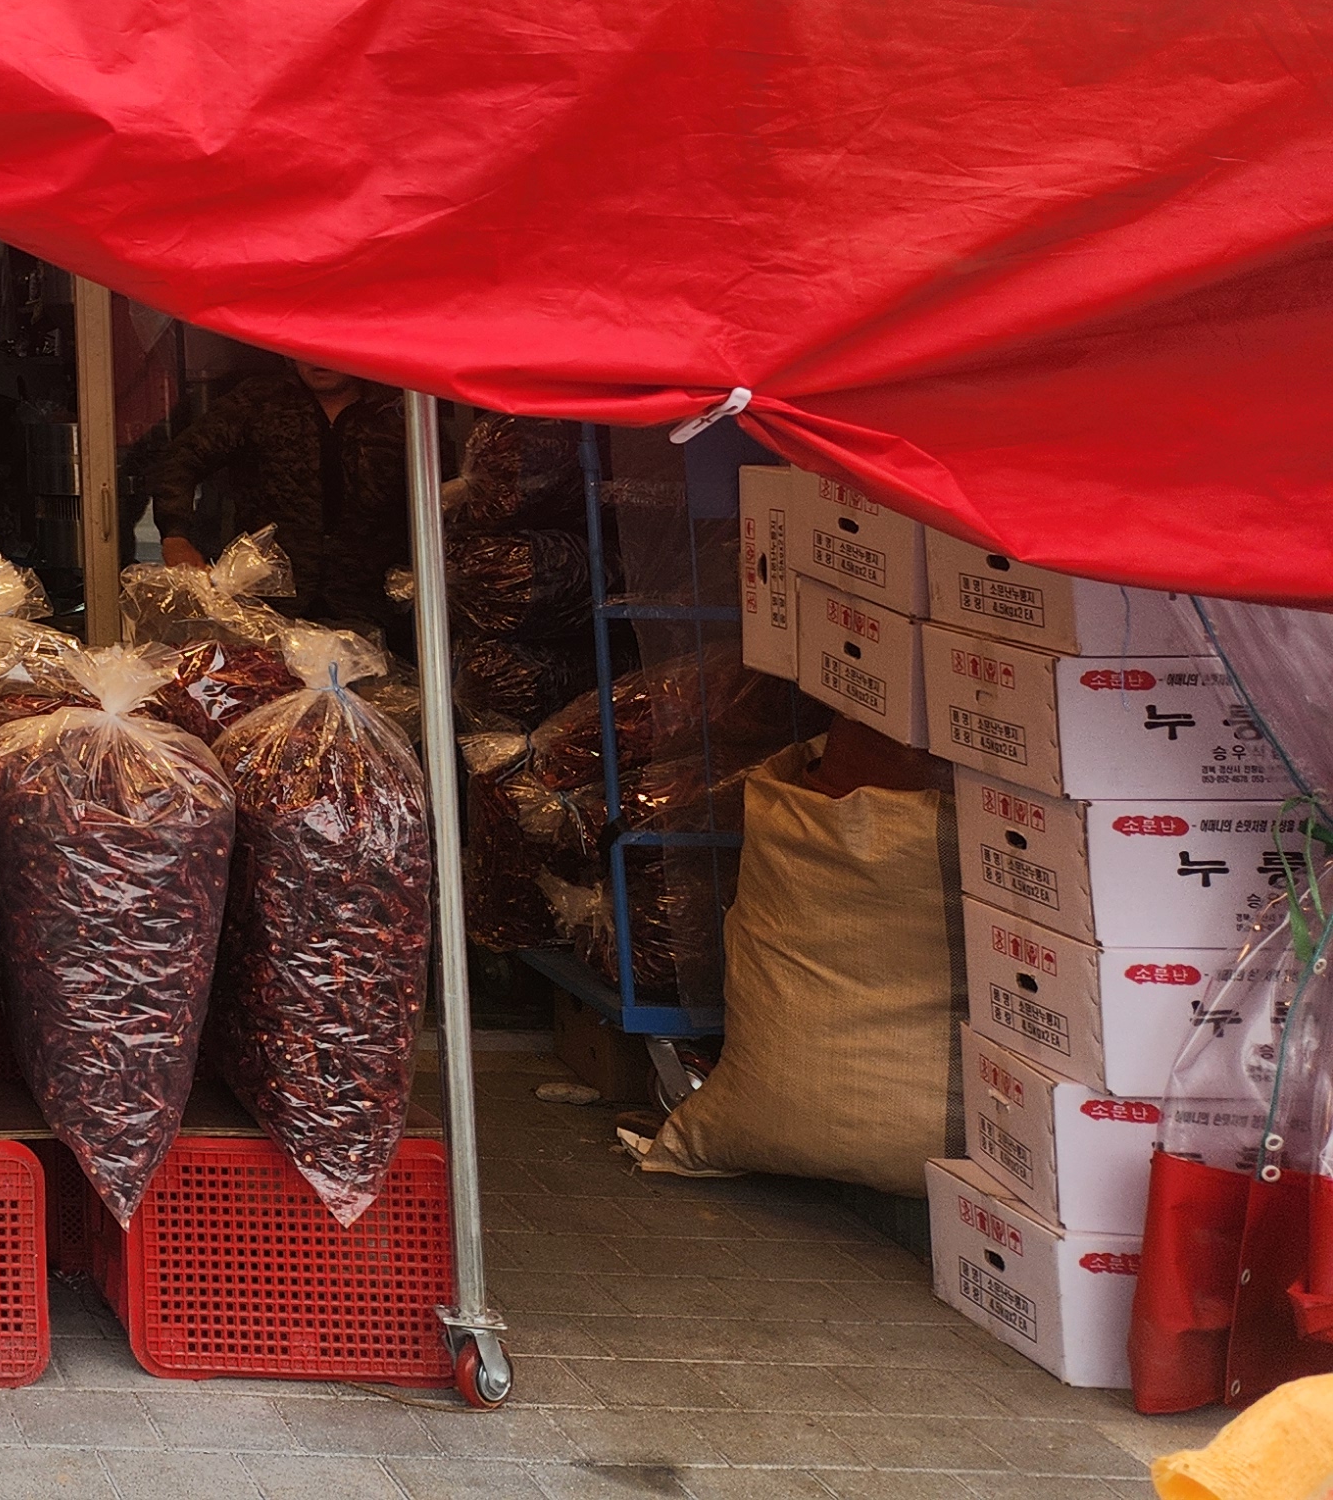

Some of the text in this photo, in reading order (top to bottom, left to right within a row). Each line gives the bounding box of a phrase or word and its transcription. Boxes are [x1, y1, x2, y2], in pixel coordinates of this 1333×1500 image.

[1122, 819, 1176, 833] 소문난
[1134, 968, 1188, 982] 소문난
[1090, 1104, 1149, 1121] 소문난
